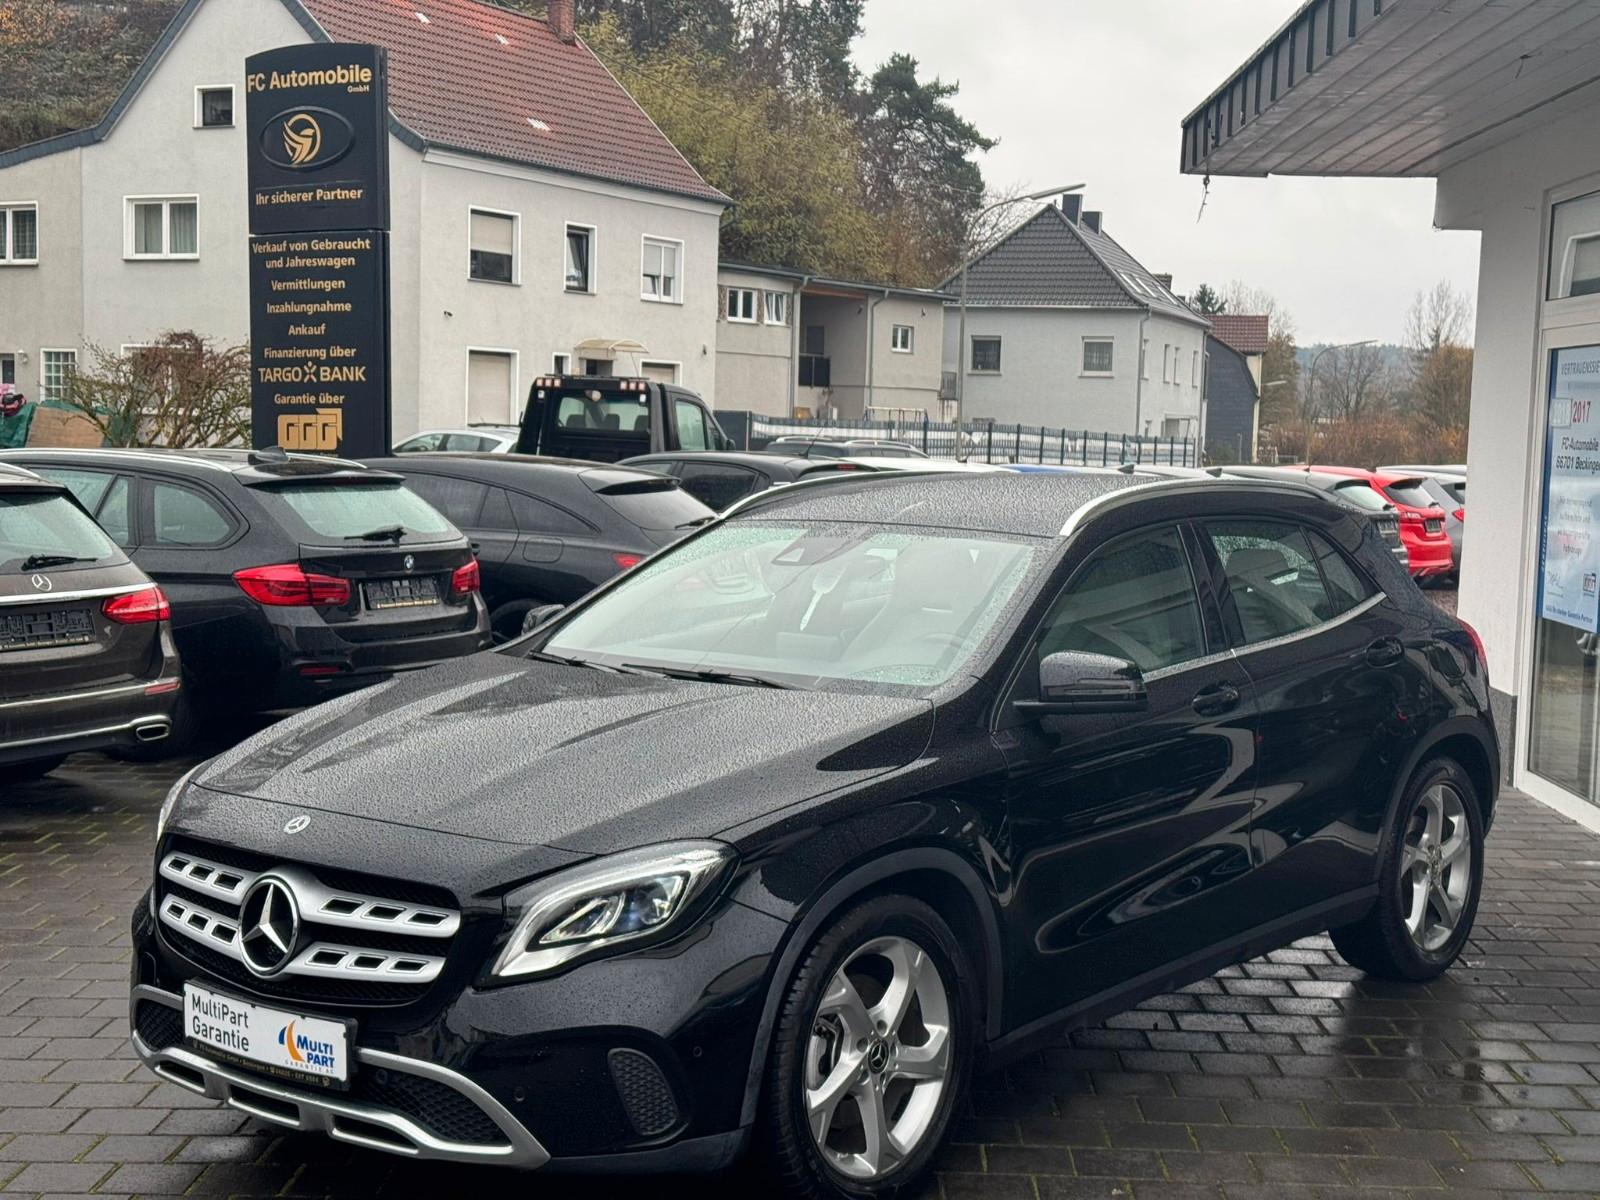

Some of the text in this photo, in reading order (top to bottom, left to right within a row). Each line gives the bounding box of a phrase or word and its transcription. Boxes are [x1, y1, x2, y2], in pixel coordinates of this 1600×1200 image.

[247, 64, 372, 92] FC Automobile
[347, 84, 370, 93] GmbH
[255, 188, 363, 205] Ihr sicherer Partner
[252, 238, 371, 254] Verkauf von Gebraucht
[265, 255, 355, 269] und Jahreswagen
[271, 277, 346, 291] Vermittlungen
[266, 300, 352, 315] Inzahlungnahme
[288, 323, 326, 335] Ankauf
[264, 346, 356, 360] Finanzierung über
[258, 366, 366, 382] TARGO BANK
[274, 392, 345, 405] Garantie über
[1572, 400, 1591, 423] 2017
[1556, 455, 1574, 469] 66701
[192, 993, 249, 1028] MultiPart
[192, 1016, 249, 1052] Garantie
[296, 1034, 334, 1056] MULTI
[306, 1052, 335, 1069] PART
